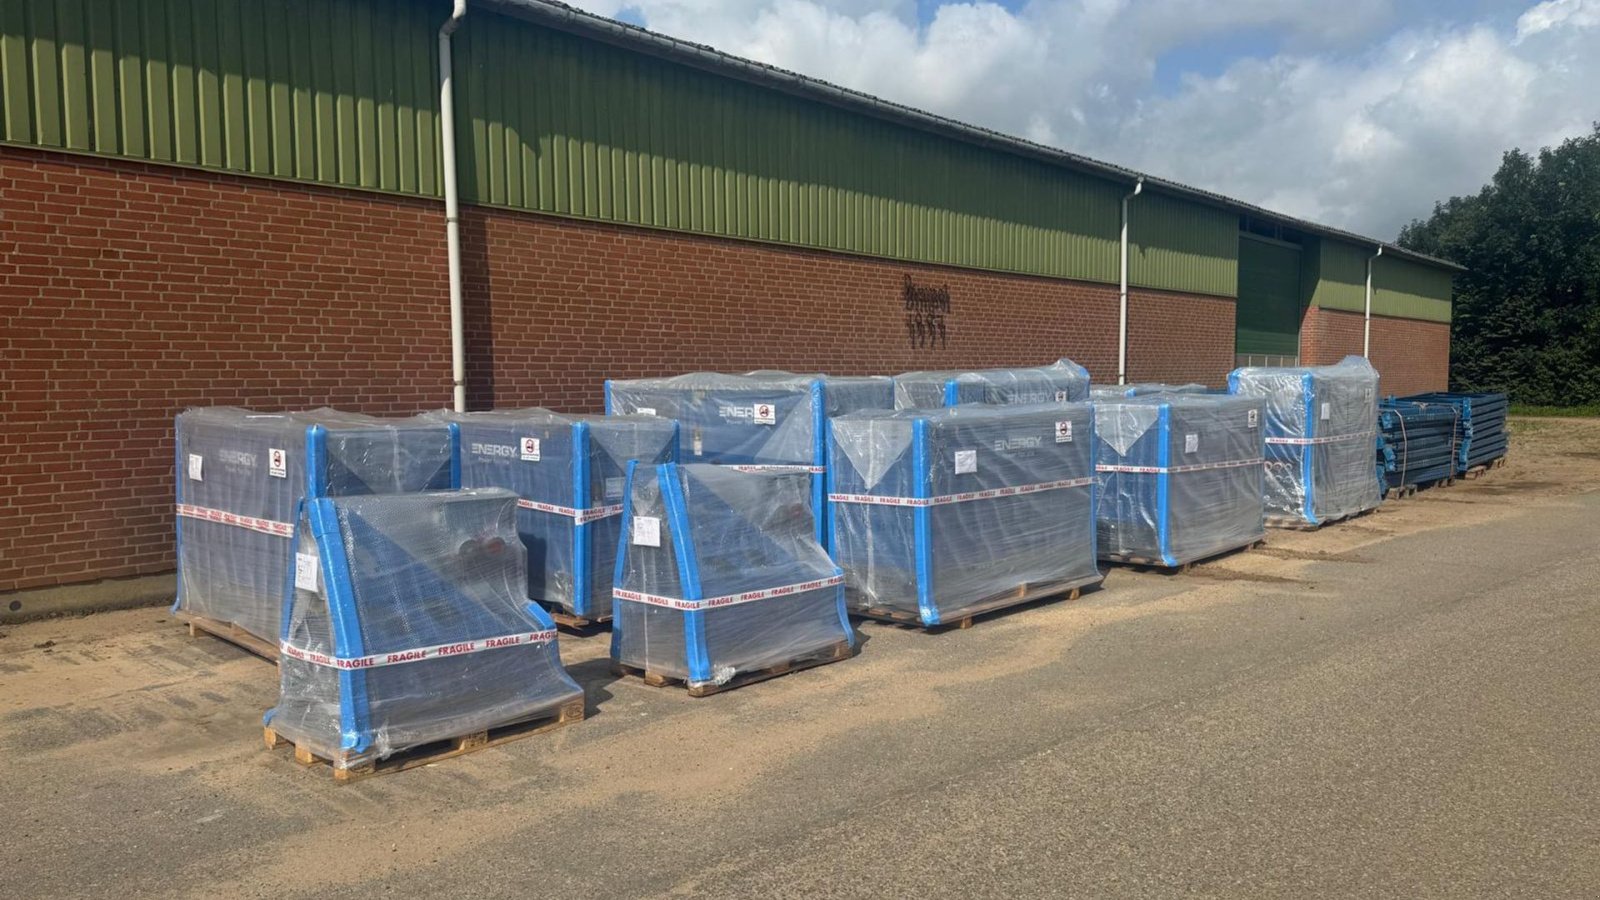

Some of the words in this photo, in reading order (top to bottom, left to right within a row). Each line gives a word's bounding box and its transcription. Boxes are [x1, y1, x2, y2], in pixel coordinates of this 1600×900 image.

[719, 406, 754, 418] ENER
[471, 443, 517, 457] ENERGY
[993, 436, 1041, 451] ENERGY
[675, 600, 700, 609] FRAGILE
[708, 596, 733, 606] FRAGILE
[741, 591, 765, 601] FRAGILE
[771, 586, 795, 597] FRAGILE
[336, 657, 375, 669] FRAGILE
[387, 650, 426, 663] FRAGILE
[438, 642, 475, 656] FRAGILE
[486, 636, 521, 648] FRAGILE
